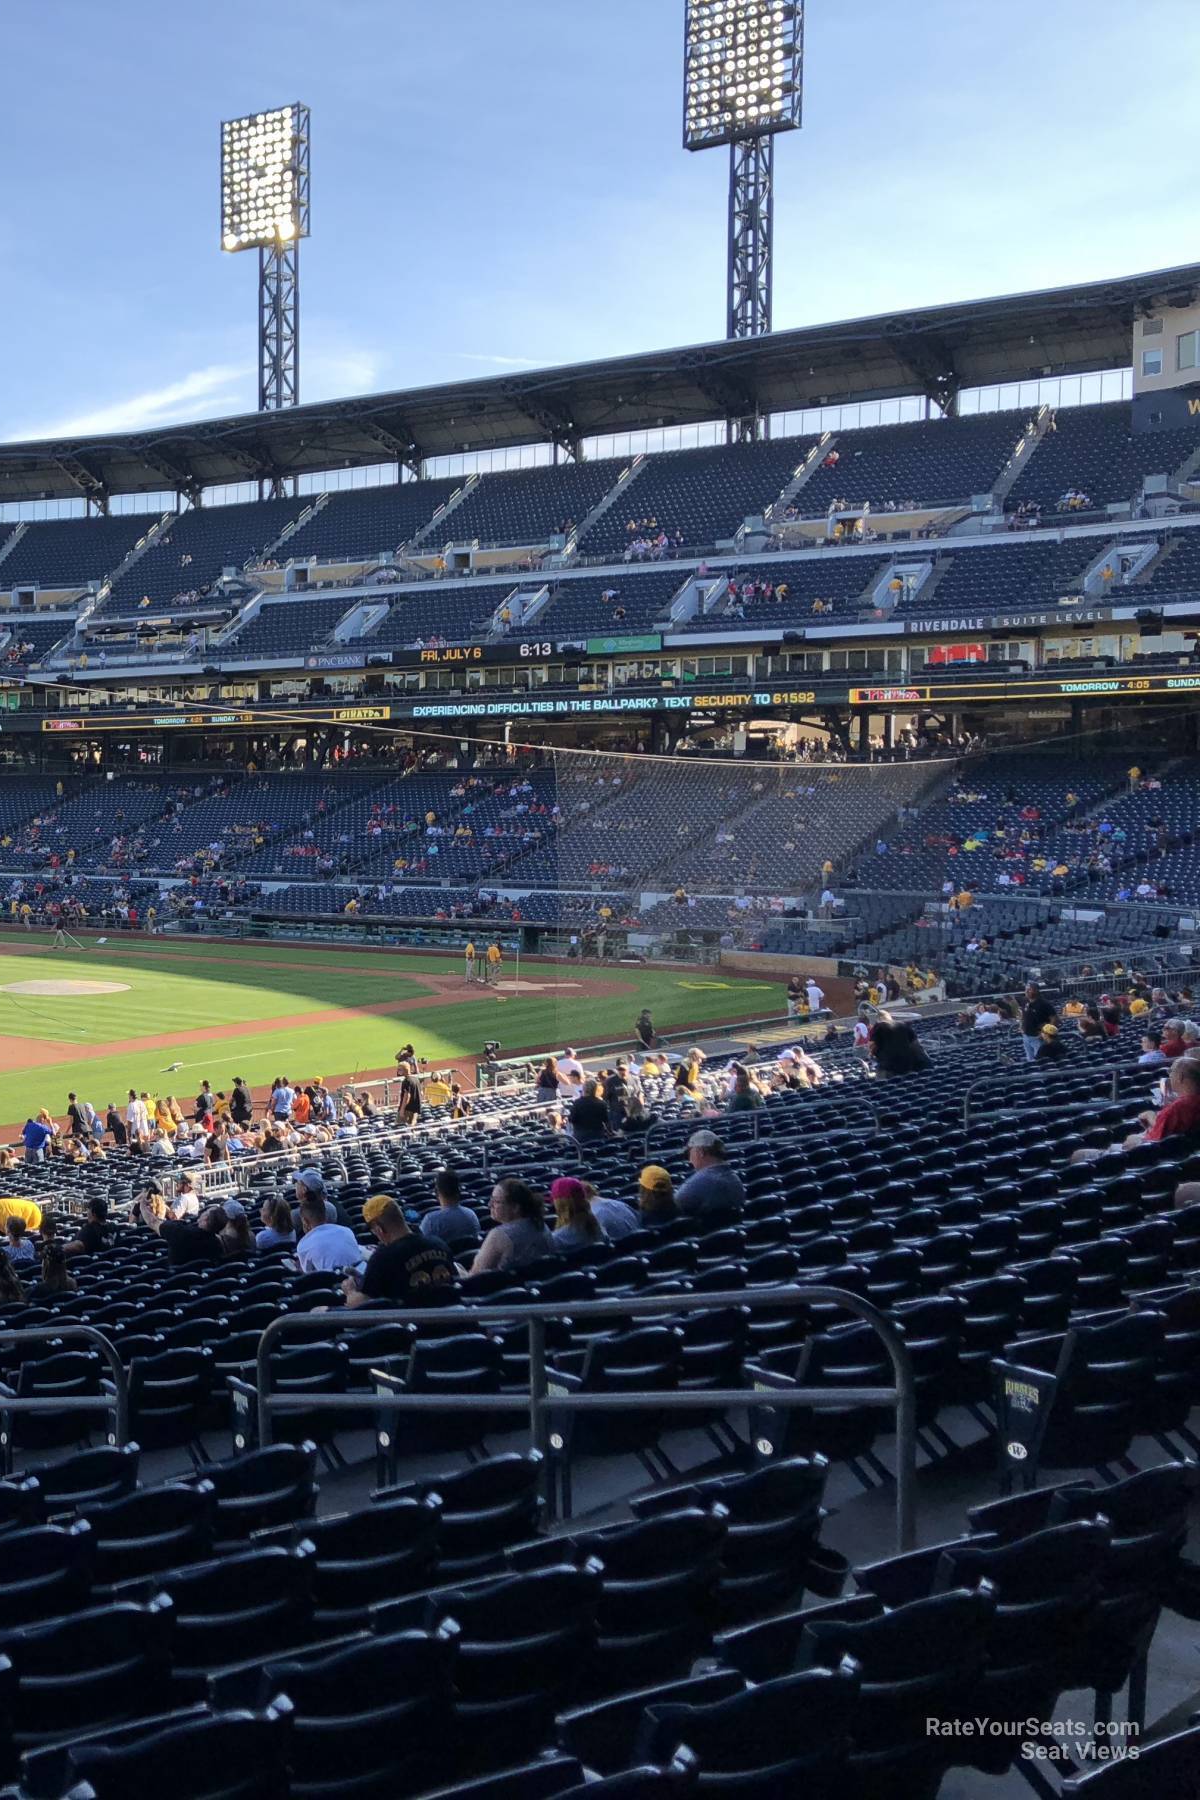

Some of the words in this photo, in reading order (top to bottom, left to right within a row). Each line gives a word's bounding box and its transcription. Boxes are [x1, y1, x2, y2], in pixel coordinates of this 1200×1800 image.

[911, 618, 984, 632] RIVENDALE
[1003, 615, 1047, 626] SUITE
[1056, 611, 1103, 622] LEVEL
[421, 650, 440, 662] FRI,
[443, 648, 471, 660] JULY
[473, 647, 482, 659] 6
[519, 643, 552, 657] 6:13
[1060, 682, 1120, 692] TOMORROW
[1127, 680, 1150, 689] 4:05
[413, 704, 486, 717] EXPERIENCING
[488, 701, 554, 714] DIFFICULTIES
[556, 701, 568, 711] IN
[570, 700, 591, 711] THE
[594, 698, 658, 710] BALLPARK?
[663, 697, 692, 708] TEXT
[694, 694, 751, 706] SECURITY
[754, 694, 770, 704] TO
[773, 692, 816, 704] 61592
